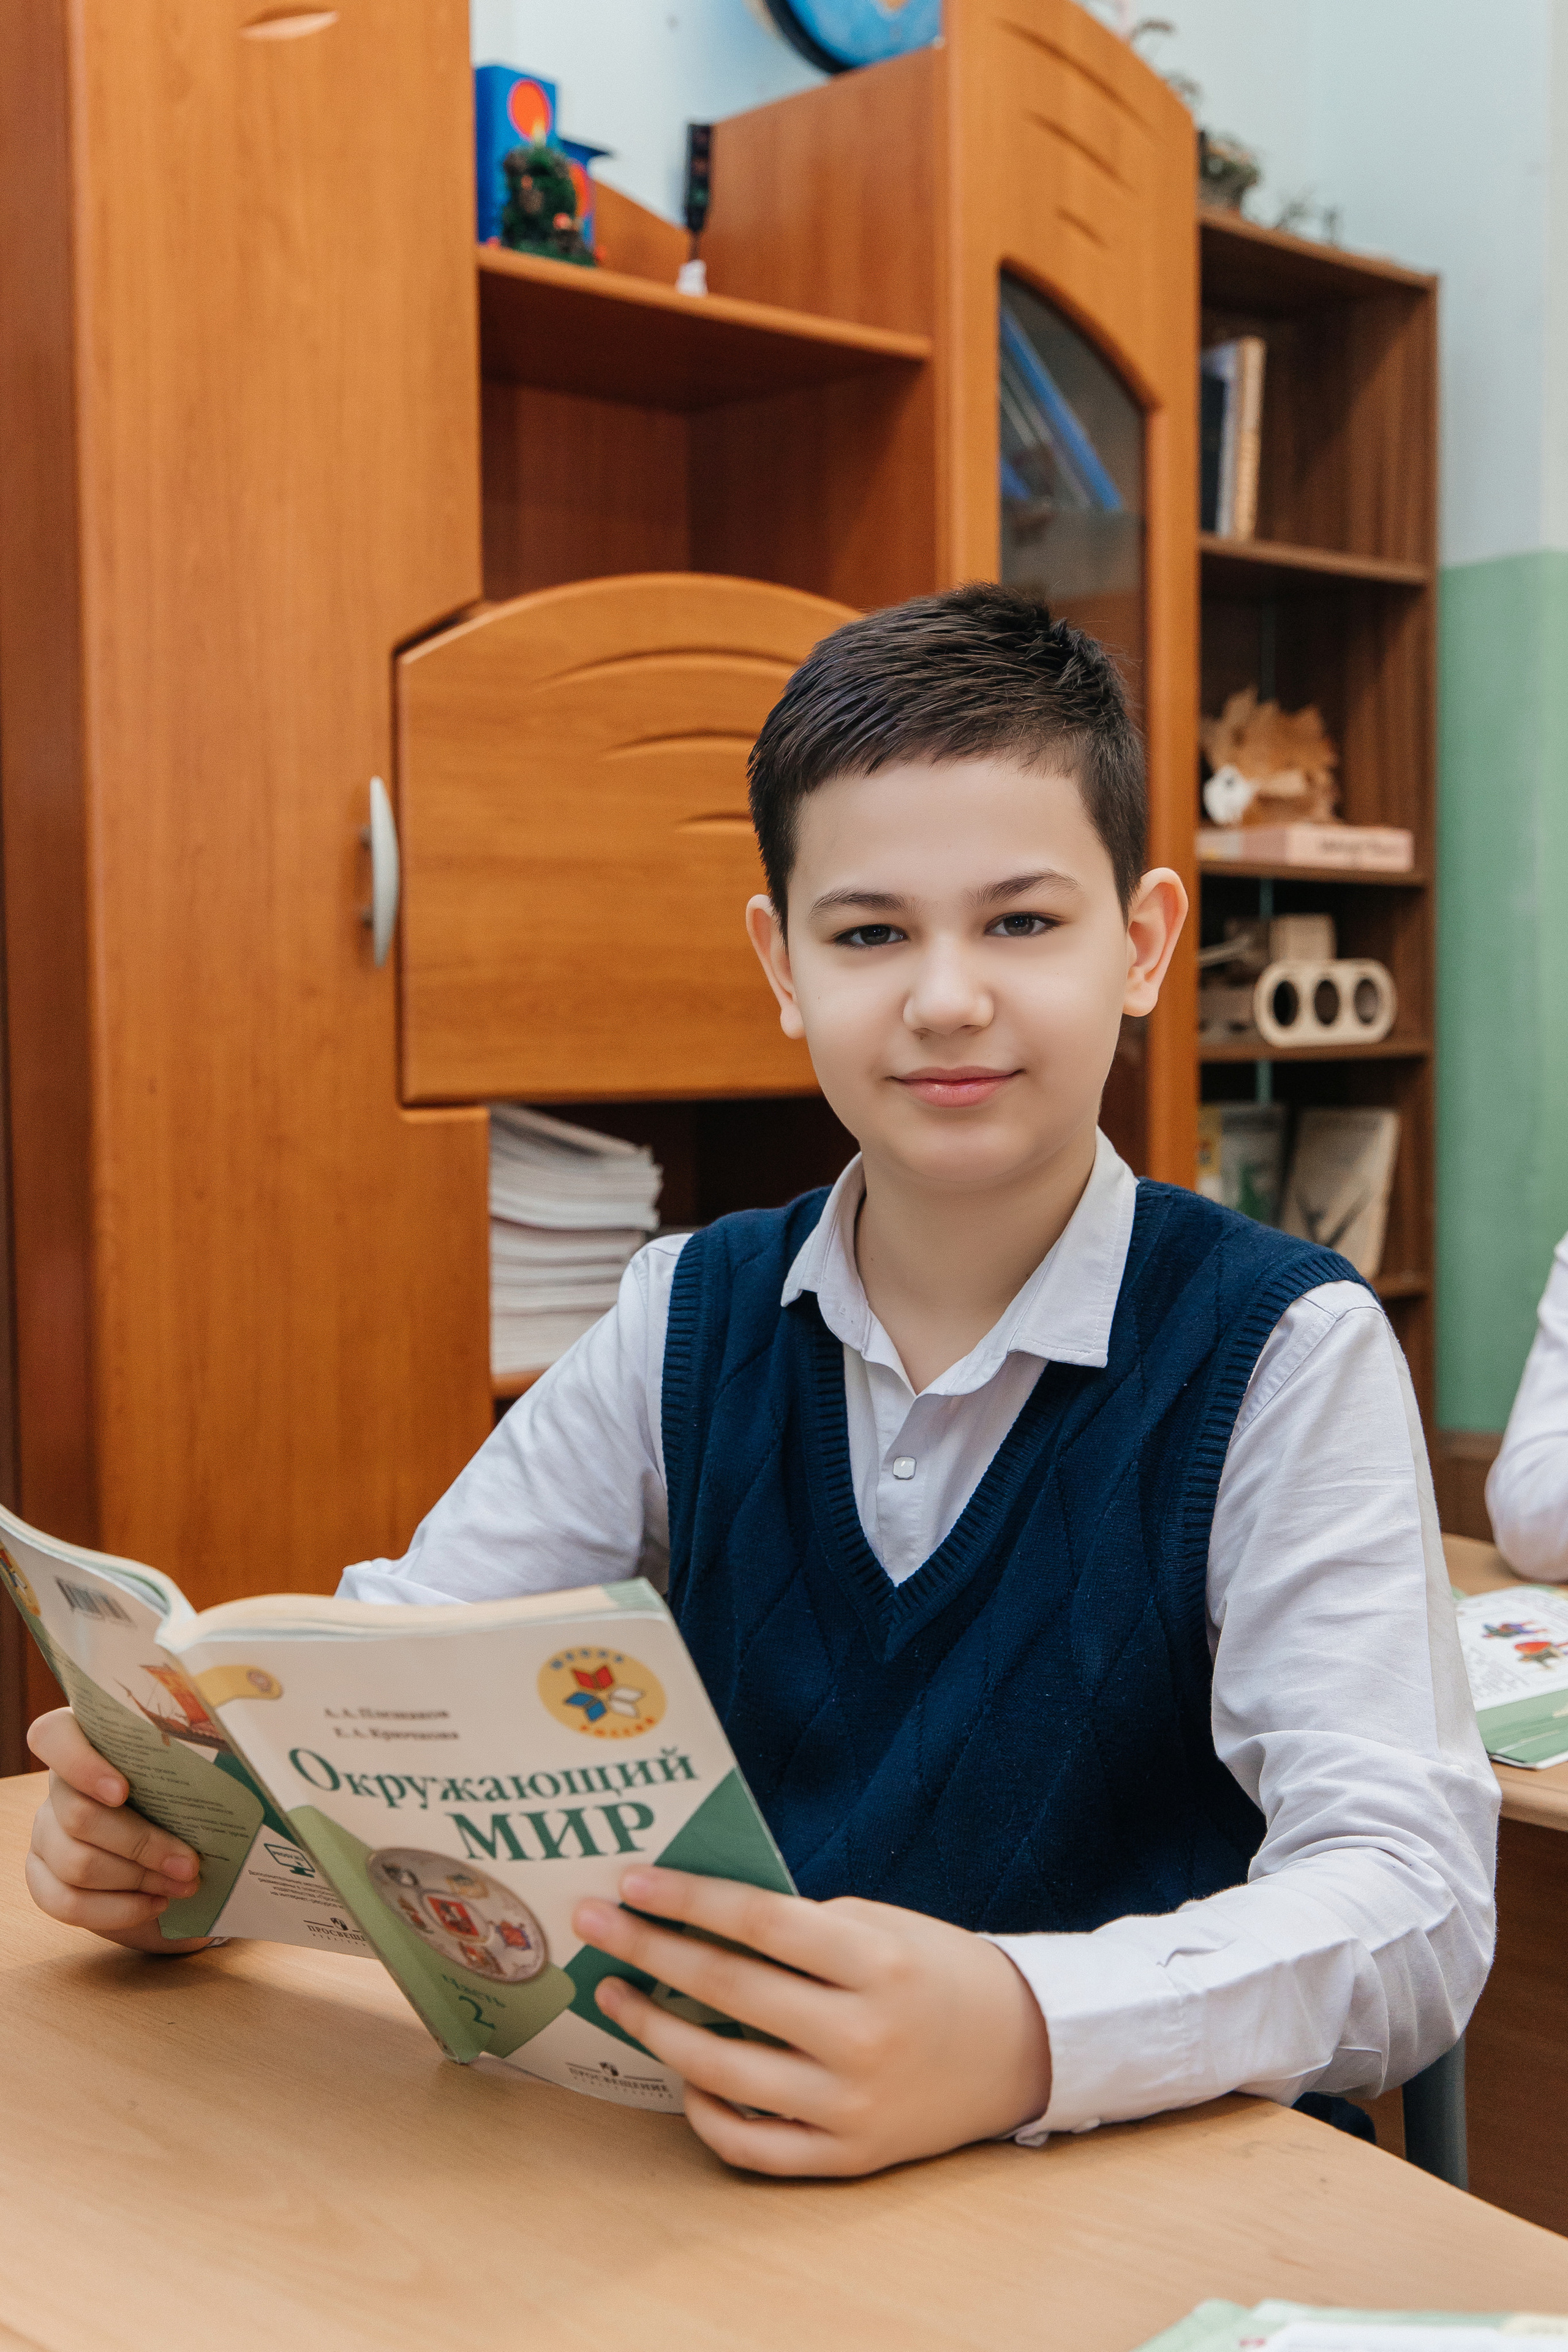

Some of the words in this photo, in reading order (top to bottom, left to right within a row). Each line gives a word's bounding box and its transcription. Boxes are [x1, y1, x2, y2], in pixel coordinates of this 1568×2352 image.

[288, 1746, 700, 1810] Окружающий
[444, 1801, 655, 1861] МИР
[458, 1995, 496, 2030] 2
